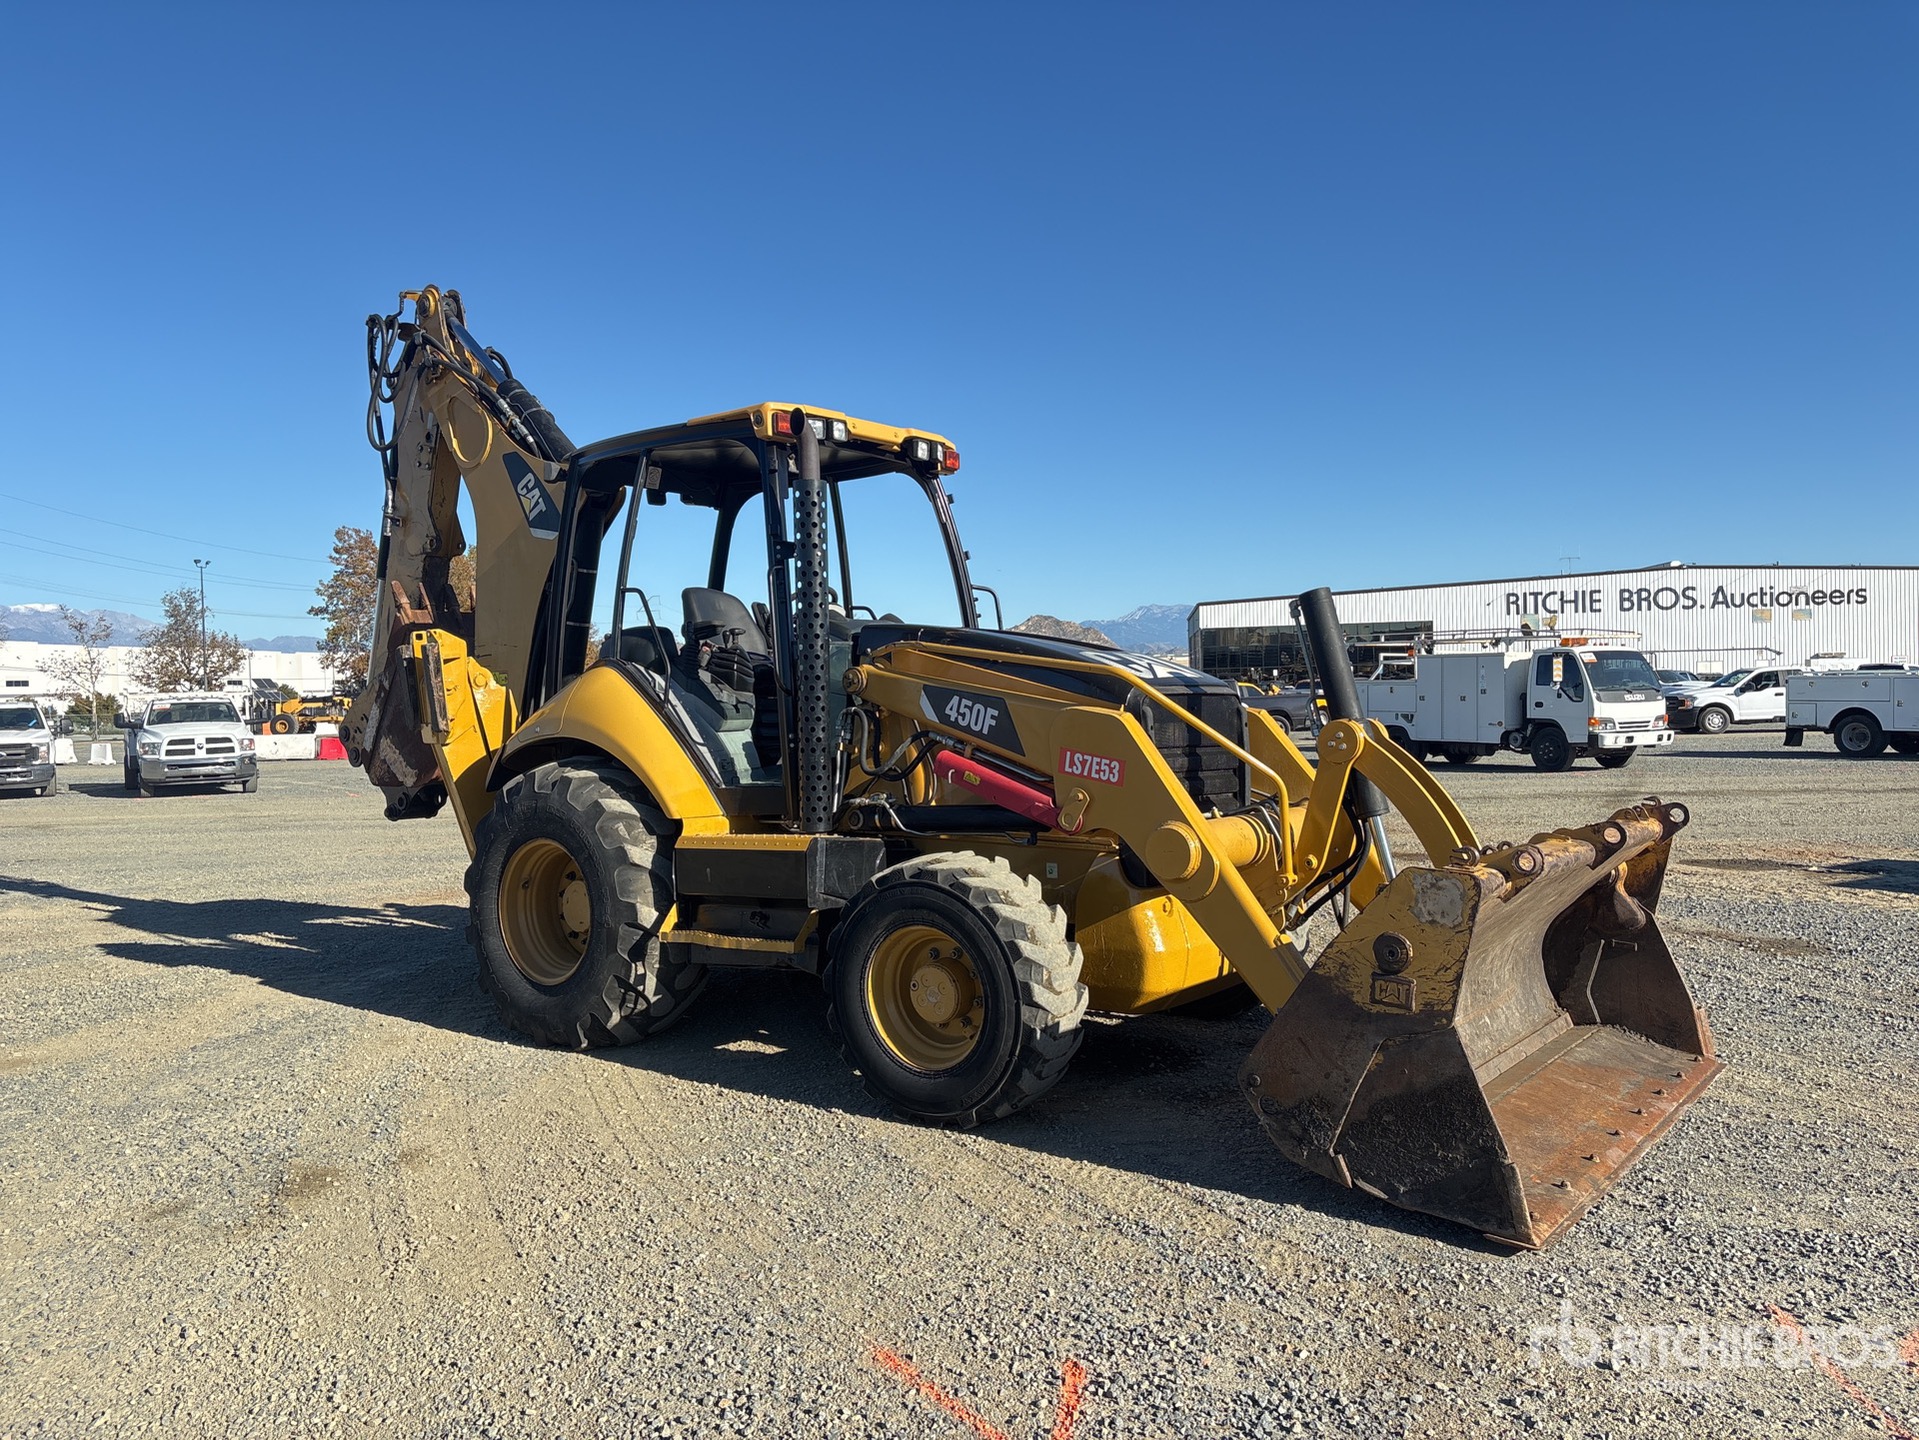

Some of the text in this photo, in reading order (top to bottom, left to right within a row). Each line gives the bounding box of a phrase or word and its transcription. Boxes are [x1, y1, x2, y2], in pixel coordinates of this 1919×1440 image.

[517, 472, 547, 521] CAT
[1506, 585, 1868, 615] RITCHIE BROS. Auctioneers
[1624, 693, 1645, 701] ISUZU
[945, 695, 999, 735] 450F
[1064, 751, 1120, 783] LS7E53
